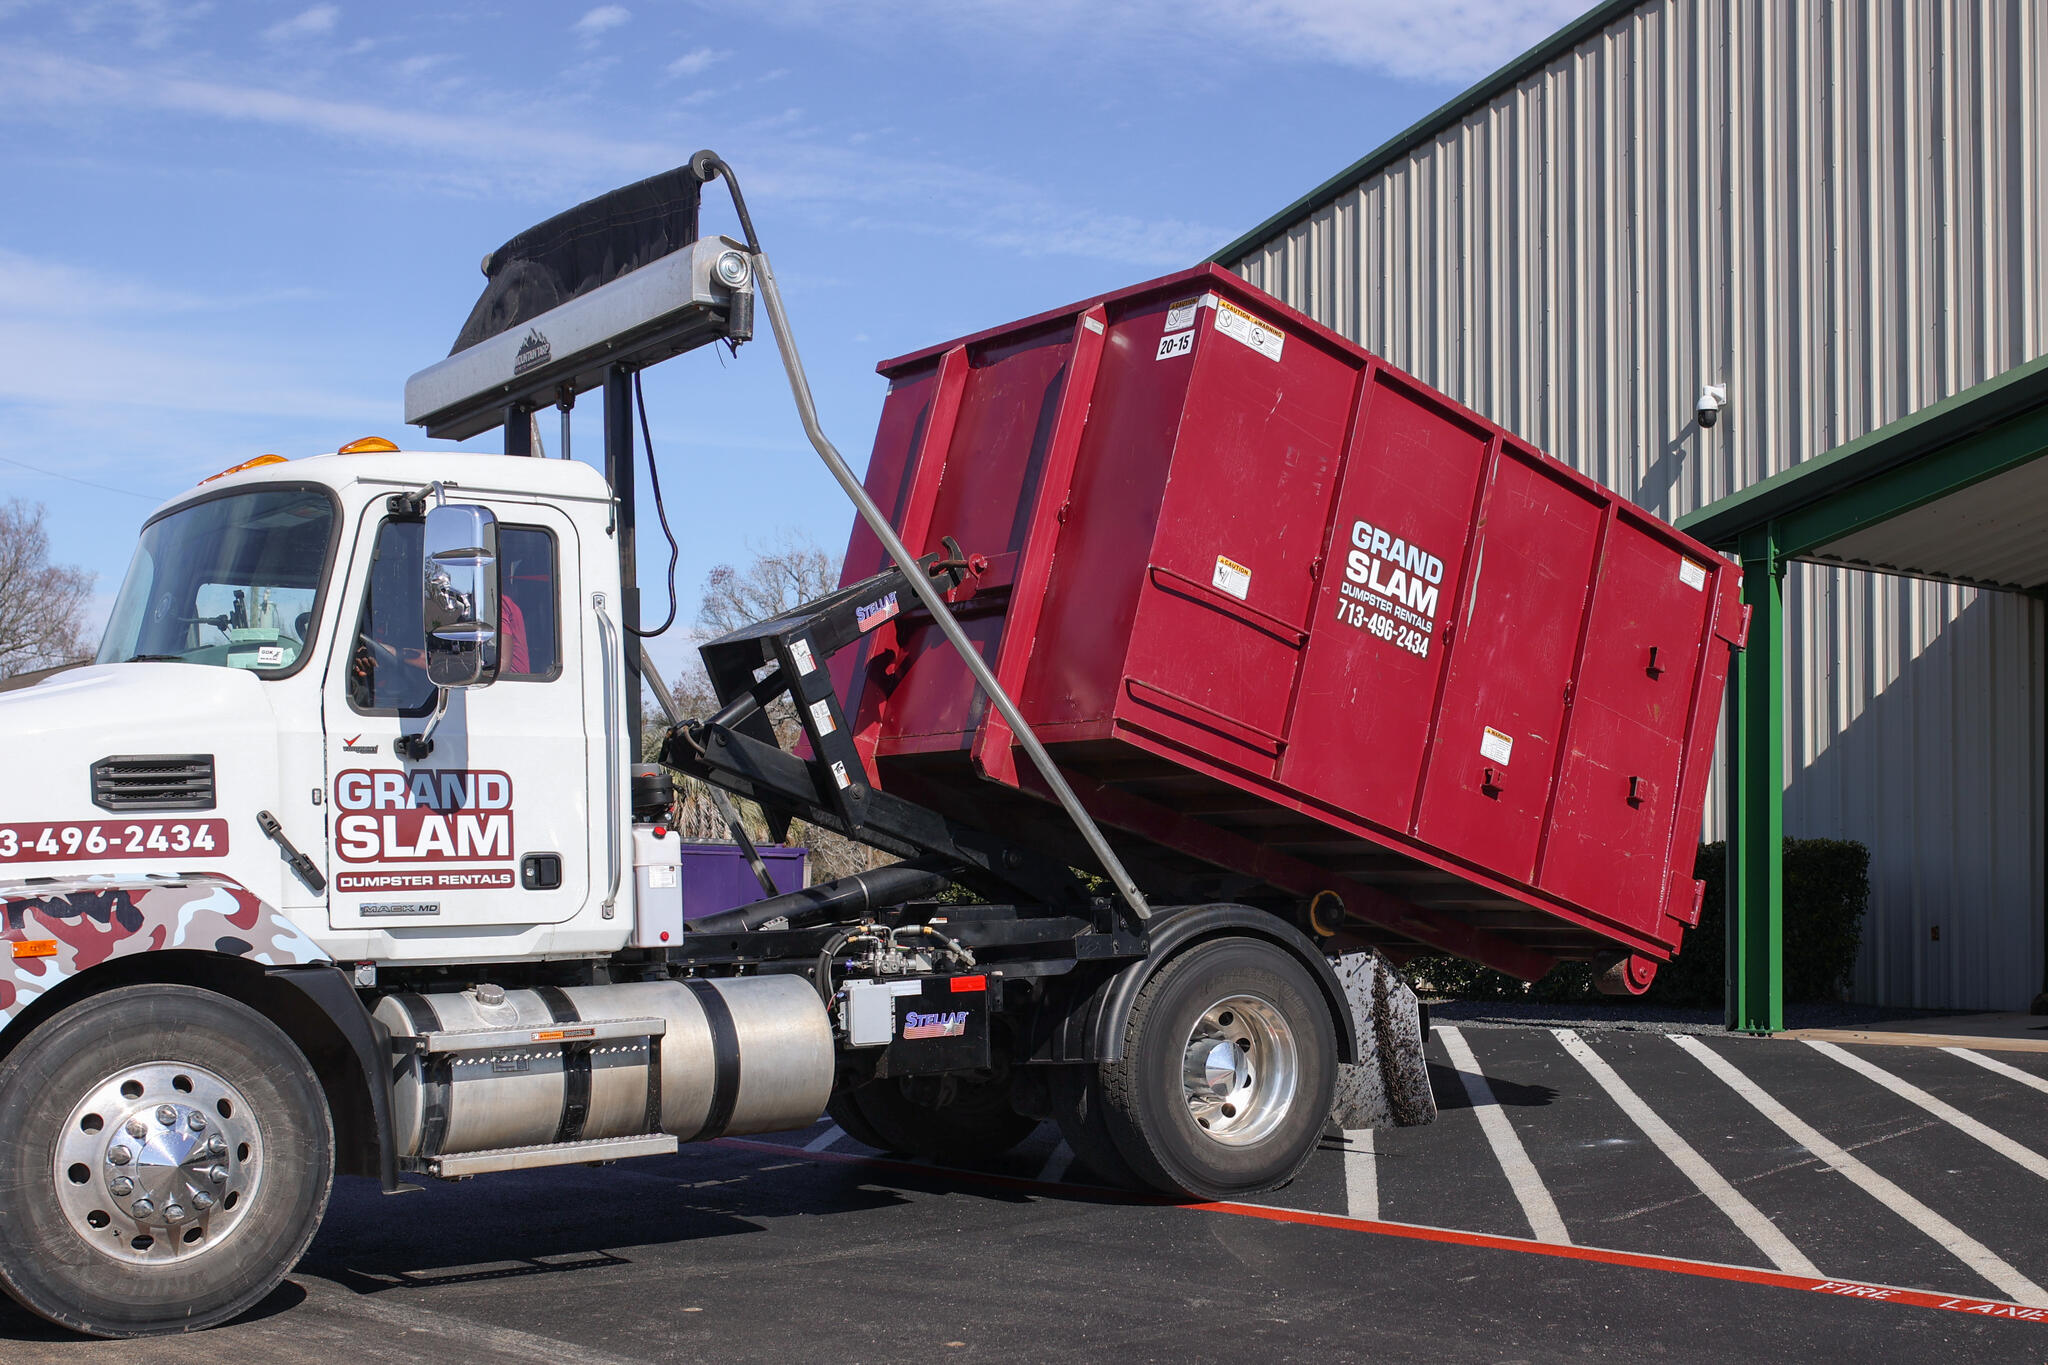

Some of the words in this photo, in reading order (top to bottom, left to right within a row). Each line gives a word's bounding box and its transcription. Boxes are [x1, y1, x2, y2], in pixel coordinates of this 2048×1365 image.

[1226, 303, 1250, 320] CAUTION
[1160, 334, 1190, 355] 20-15
[1258, 321, 1283, 338] WARNING
[1225, 559, 1249, 575] CAUTION
[1351, 520, 1444, 585] GRAND
[1346, 549, 1439, 618] SLAM
[856, 591, 897, 622] STELLAR
[1341, 581, 1393, 614] DUMPSTER
[1394, 604, 1433, 634] RENTALS
[1337, 597, 1429, 658] 713-496-2434
[338, 772, 510, 810] GRAND
[0, 824, 215, 857] 3-496-2434
[341, 814, 510, 858] SLAM
[340, 875, 435, 888] DUMPSTER
[438, 873, 511, 886] RENTALS
[363, 904, 415, 913] MACK
[418, 904, 438, 912] MD
[905, 1011, 966, 1028] STELLAR
[1811, 1281, 1901, 1300] FIRE
[1938, 1299, 2048, 1322] LANE
